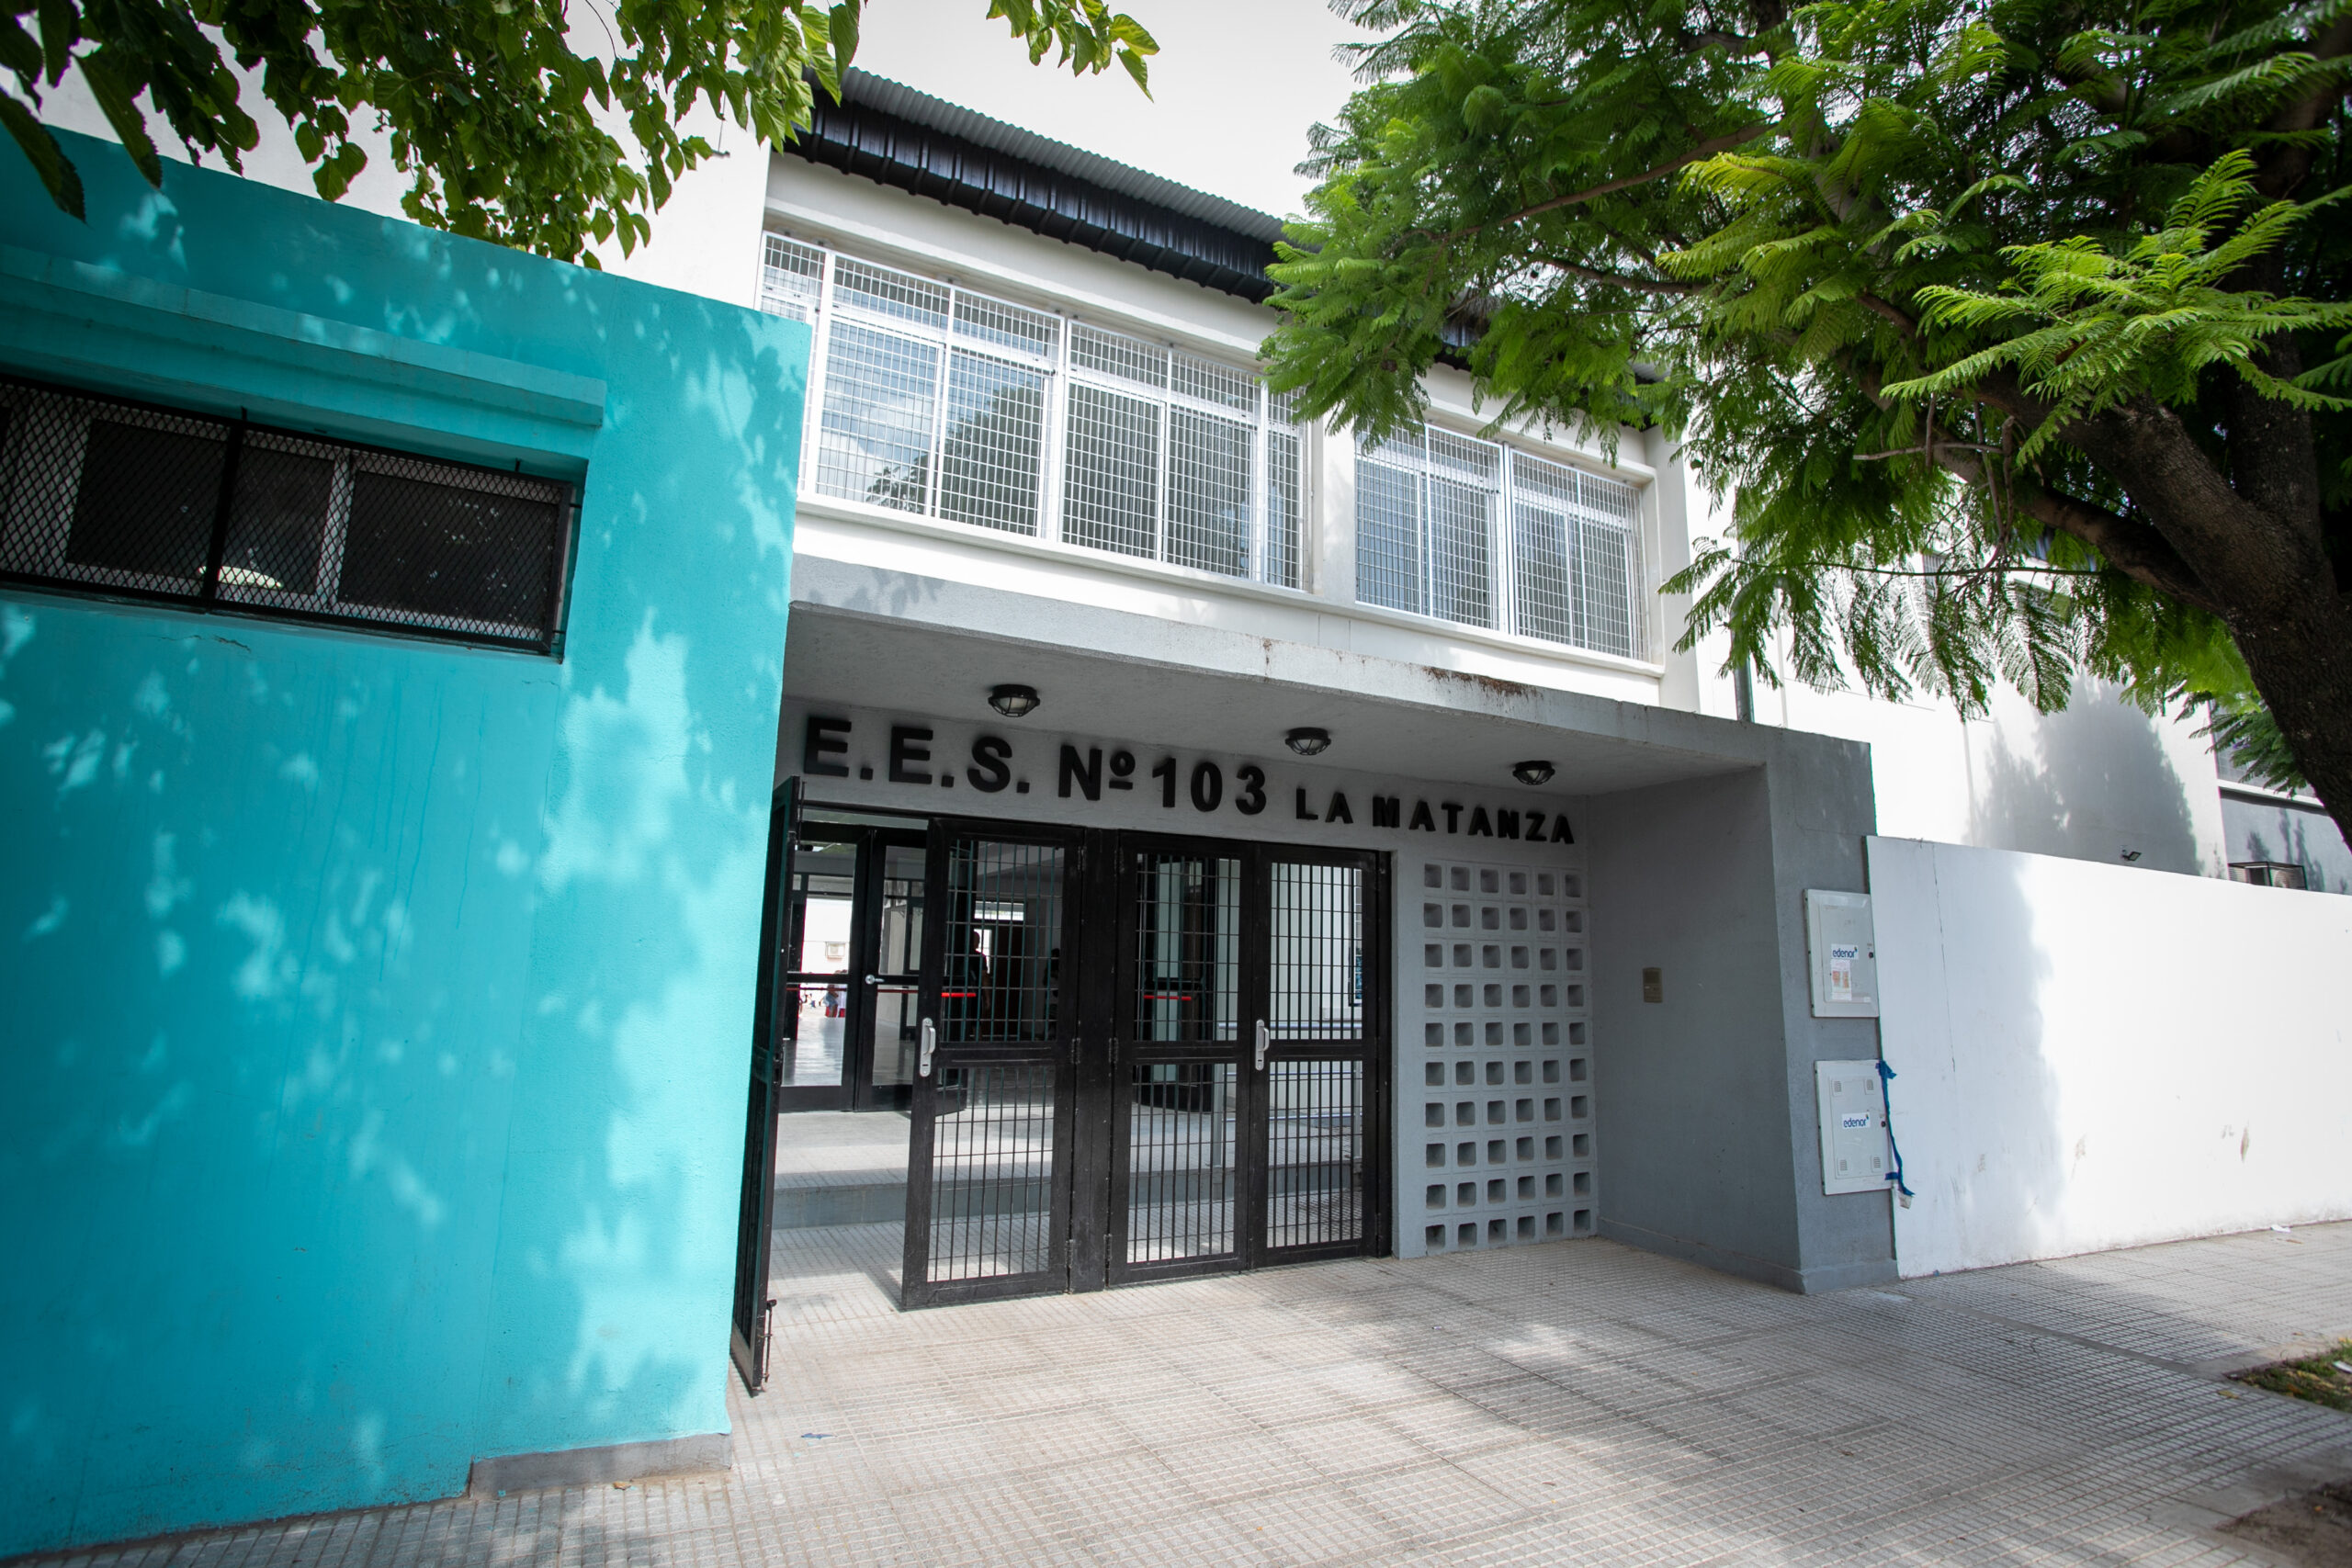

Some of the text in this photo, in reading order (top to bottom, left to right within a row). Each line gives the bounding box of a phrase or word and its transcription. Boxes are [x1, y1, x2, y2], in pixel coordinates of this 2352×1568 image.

[804, 716, 1031, 794] E.E.S.
[1295, 787, 1353, 825] LA
[1372, 795, 1576, 845] MATANZA
[1832, 947, 1856, 958] edenor
[1843, 1117, 1866, 1128] edenor
